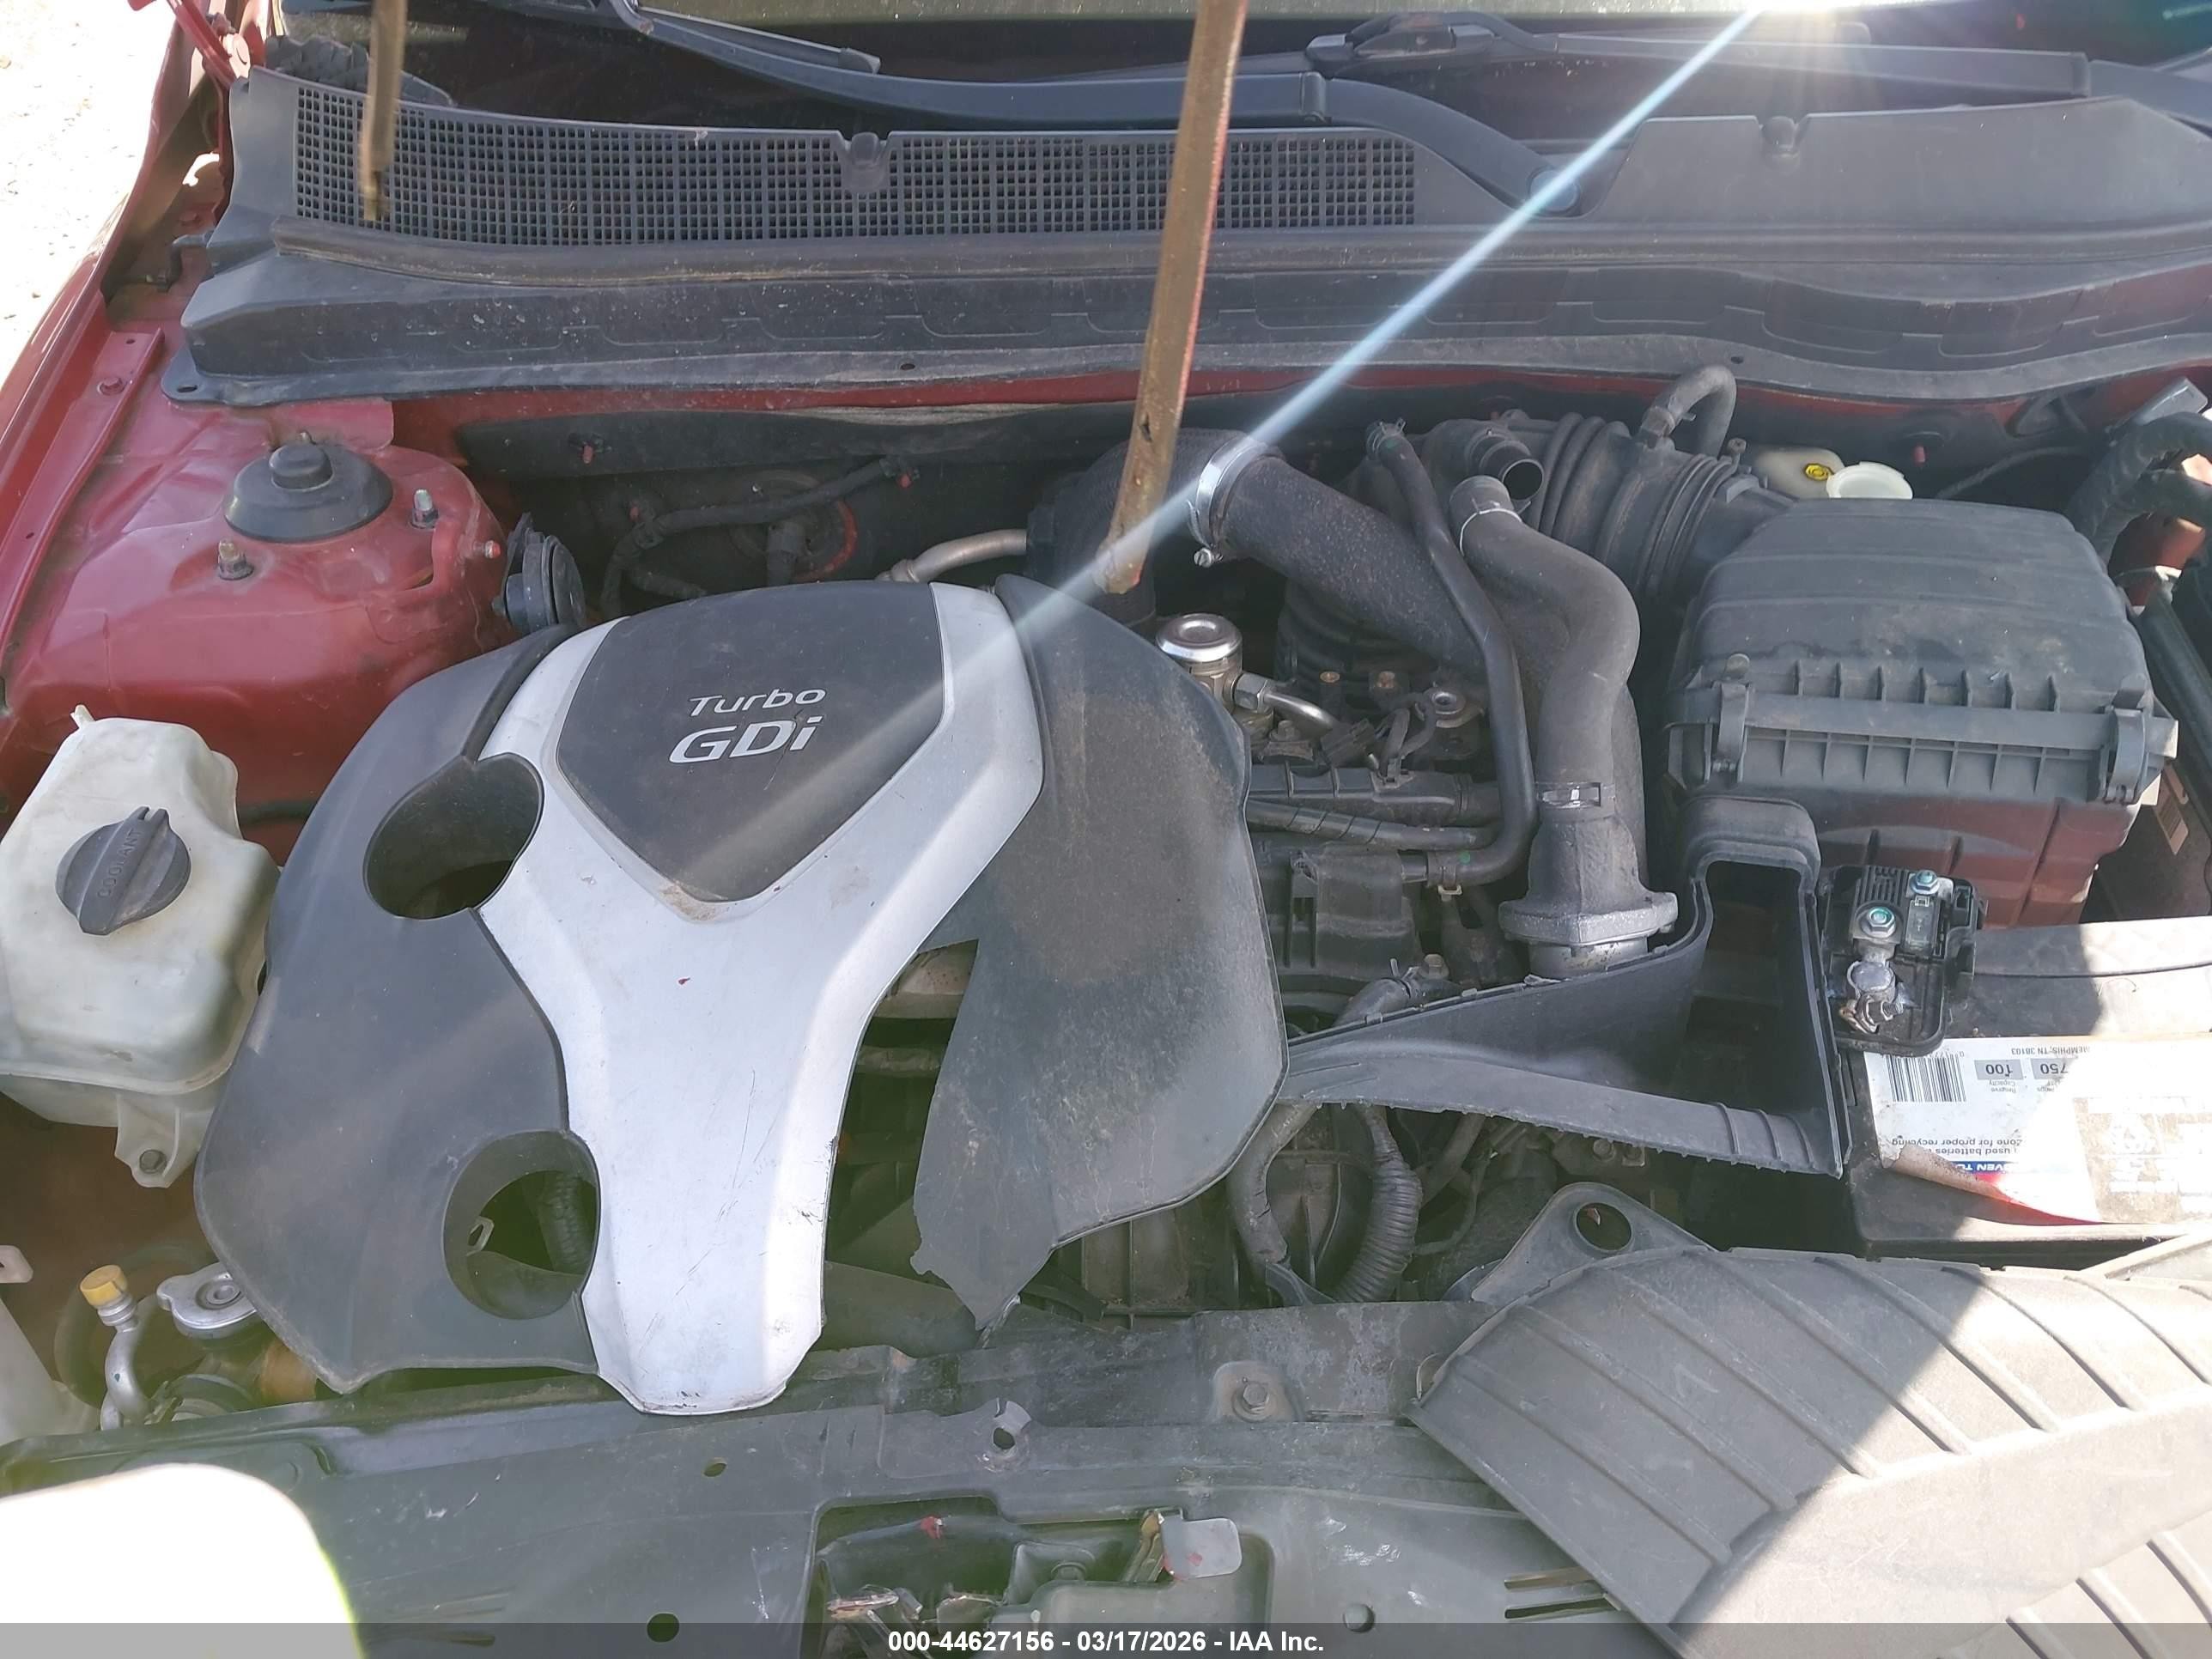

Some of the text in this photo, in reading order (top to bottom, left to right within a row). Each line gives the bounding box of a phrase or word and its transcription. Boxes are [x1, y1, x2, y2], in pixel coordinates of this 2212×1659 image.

[689, 688, 827, 717] Turbo
[668, 715, 823, 764] GDi
[96, 826, 143, 899] COOLANT
[1985, 1064, 2014, 1074] 100
[2039, 1063, 2069, 1074] 750
